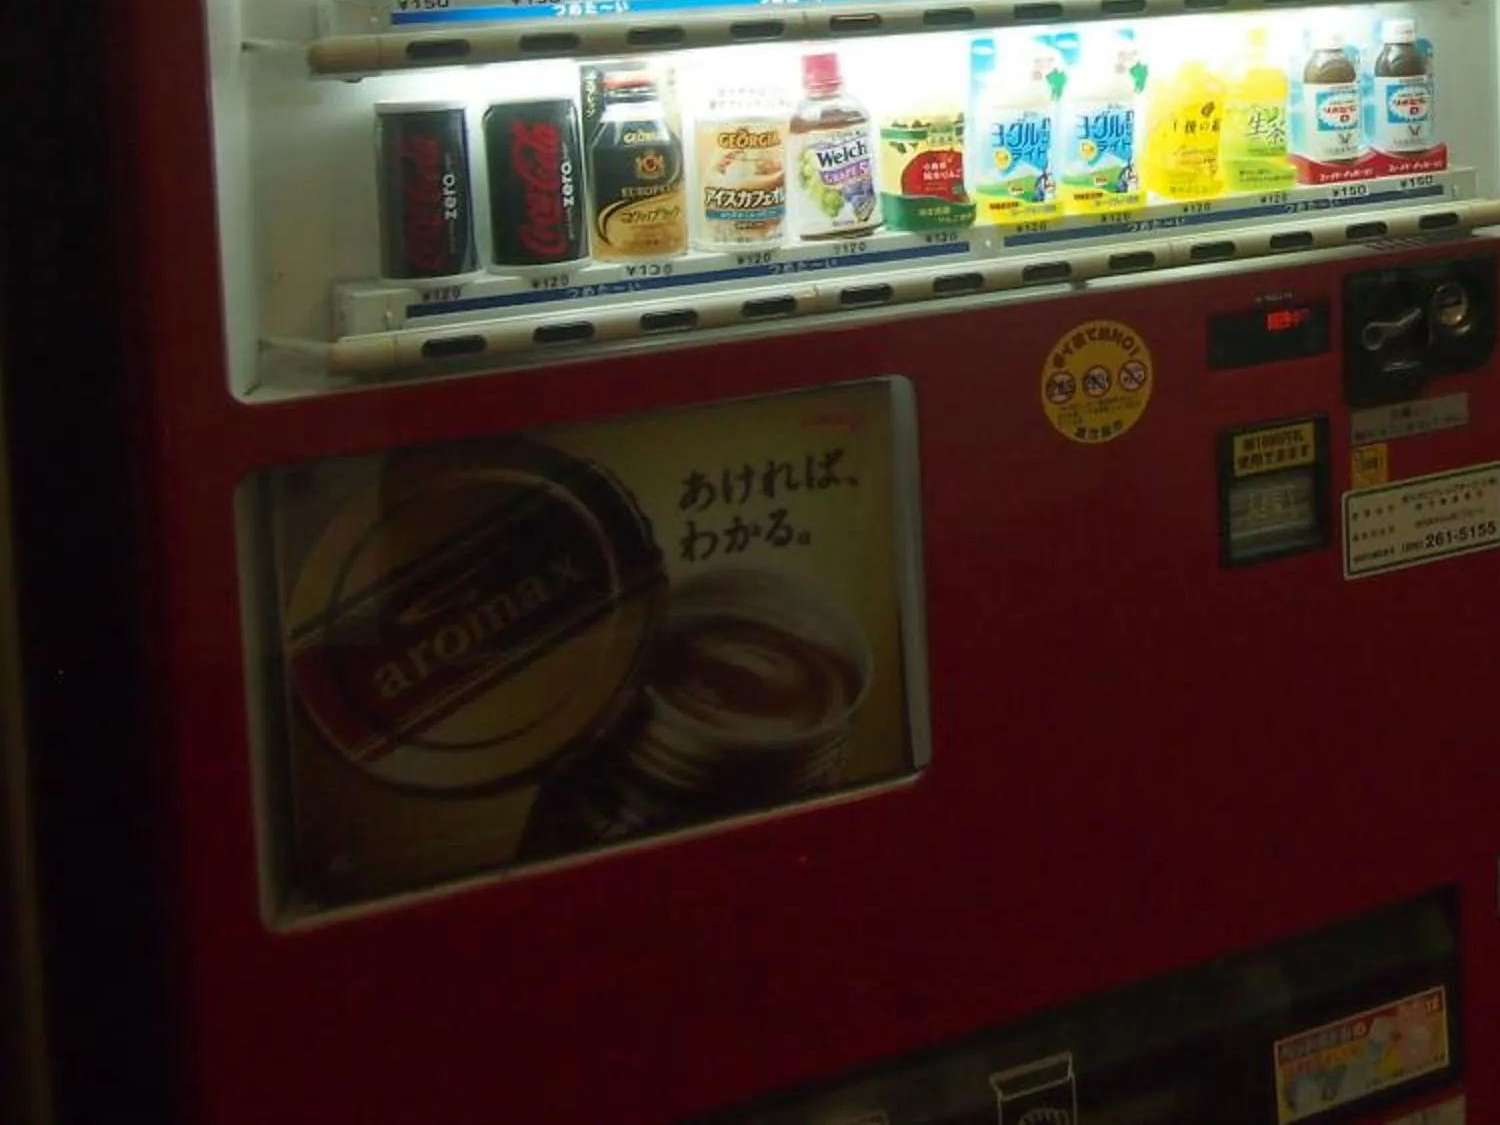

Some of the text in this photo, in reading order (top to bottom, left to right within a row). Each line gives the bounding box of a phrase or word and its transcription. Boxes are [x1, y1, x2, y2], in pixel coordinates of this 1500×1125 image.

[442, 173, 457, 220] zero
[560, 161, 576, 208] zero
[1332, 184, 1369, 199] ¥150
[677, 448, 860, 514] あければ、
[678, 509, 814, 563] わかる。
[373, 551, 583, 701] aromax
